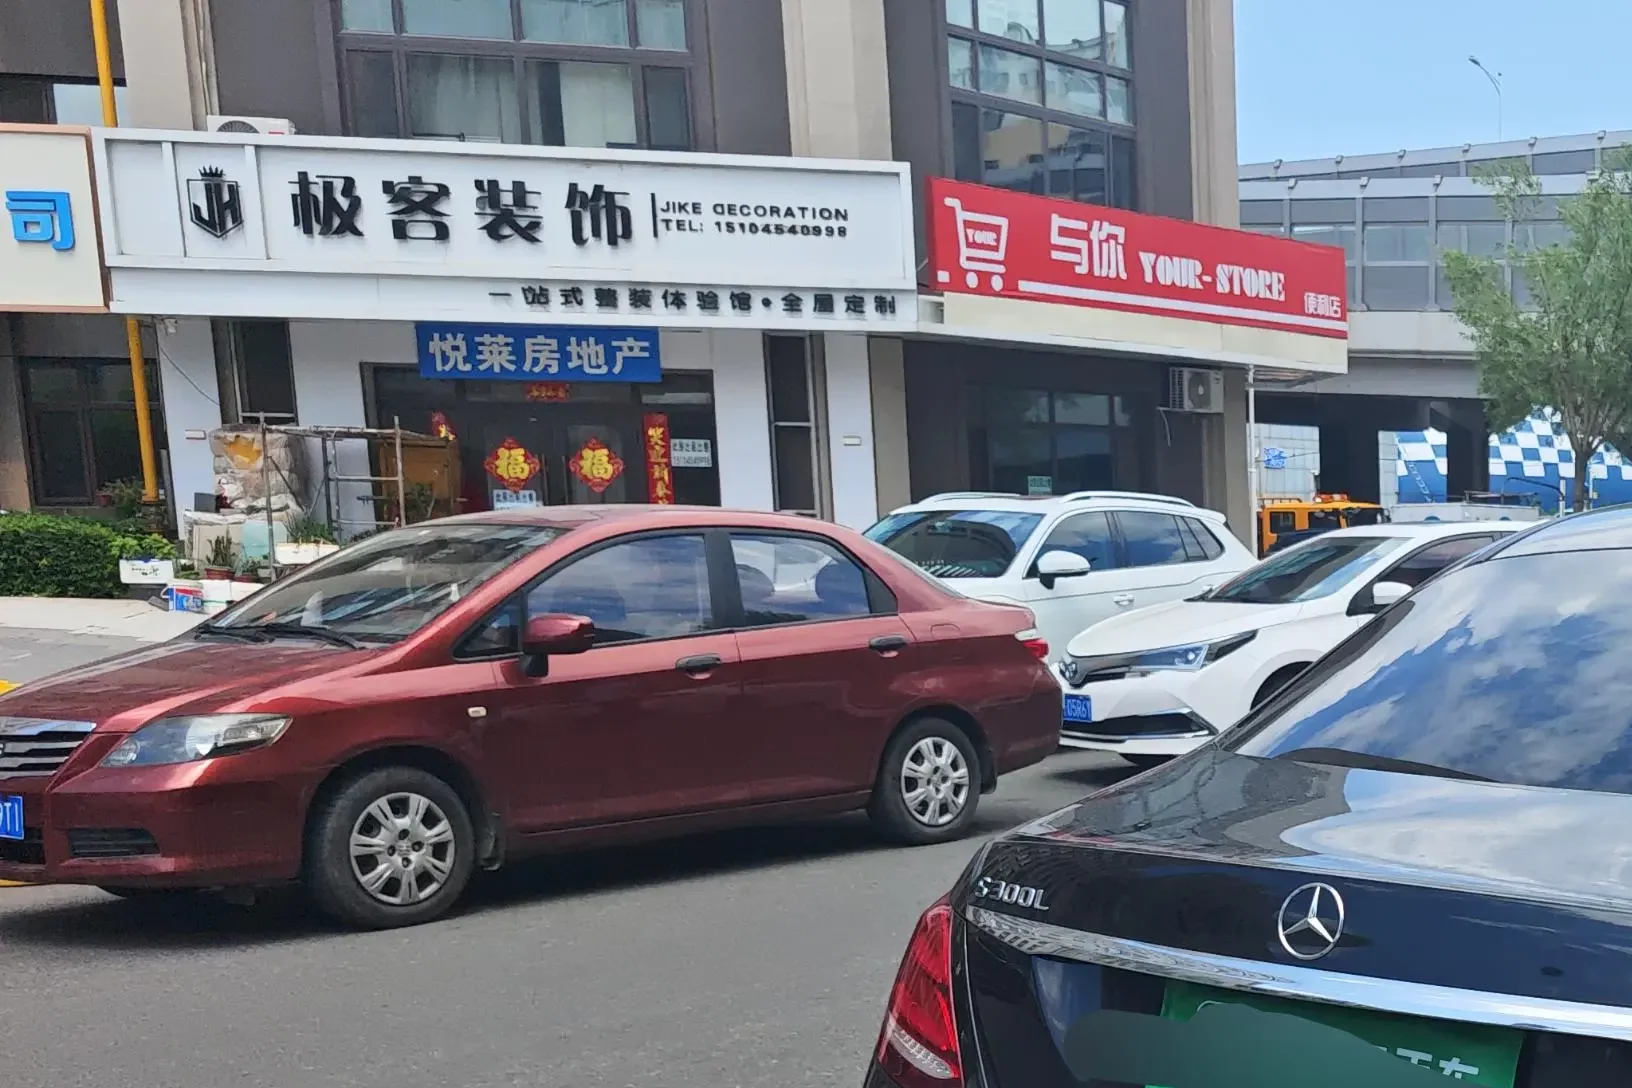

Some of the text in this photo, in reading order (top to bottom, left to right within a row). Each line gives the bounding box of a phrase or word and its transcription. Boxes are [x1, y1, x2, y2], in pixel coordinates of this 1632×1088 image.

[5, 190, 76, 251] 司
[288, 171, 633, 247] 极客装饰
[660, 200, 849, 222] JIKE DECORATION
[661, 218, 704, 232] TEL:
[966, 228, 998, 246] YOUR
[1050, 213, 1128, 281] 与你
[1304, 292, 1341, 317] 便利店
[428, 332, 650, 375] 悦莱房地产
[496, 447, 530, 480] 福
[580, 447, 614, 480] 福
